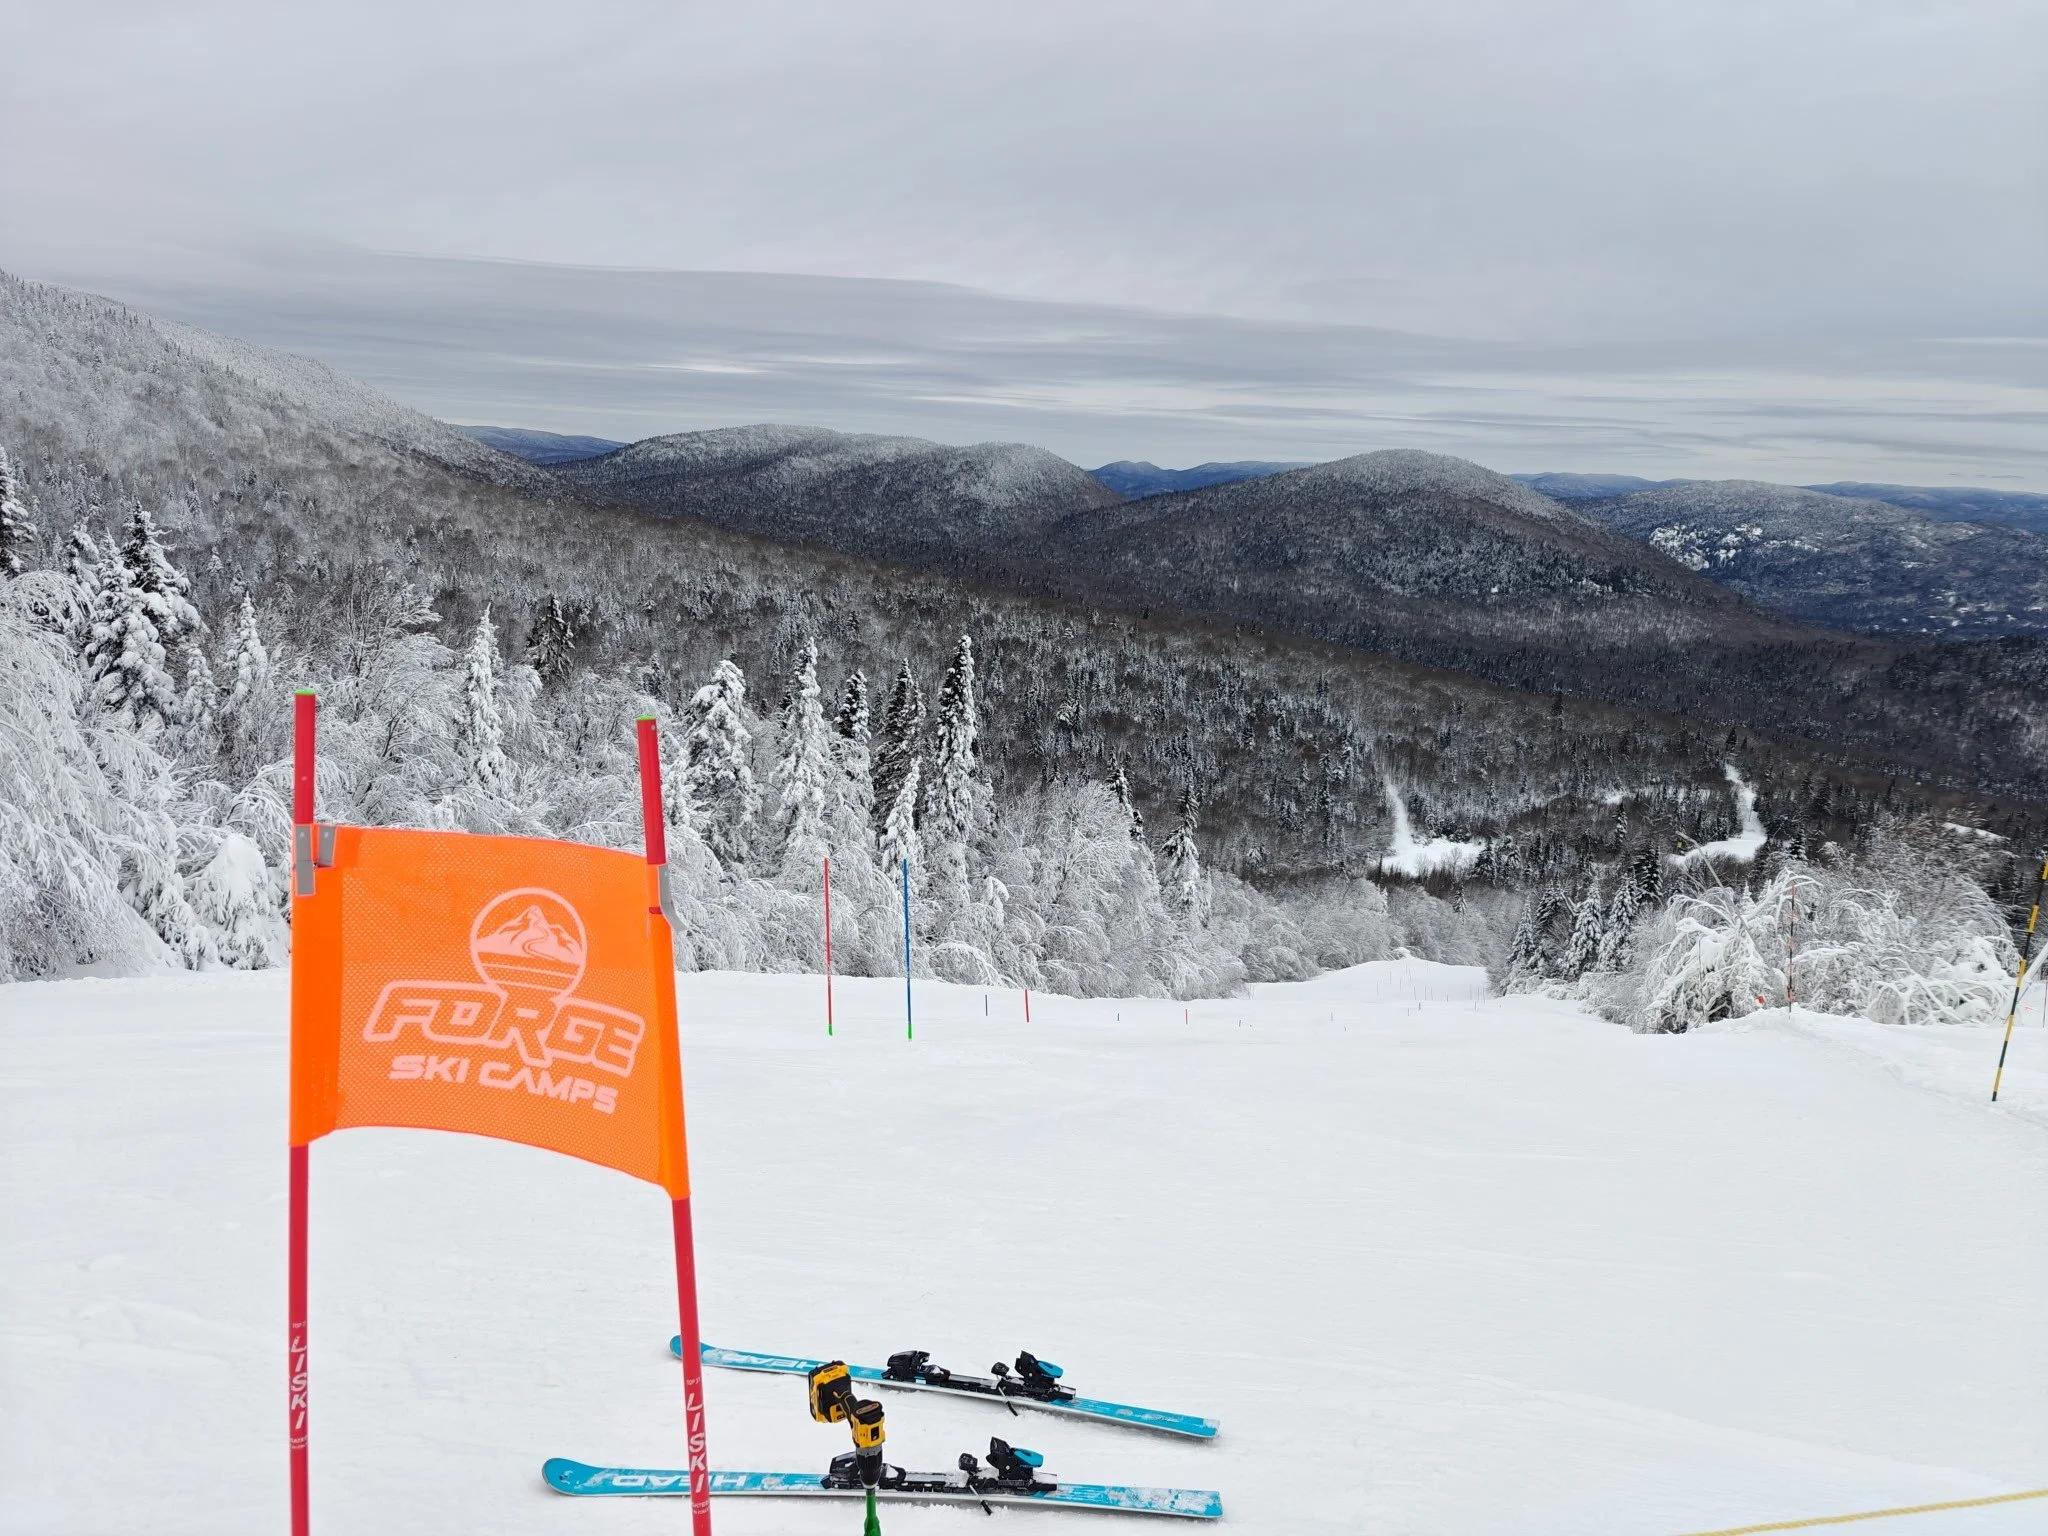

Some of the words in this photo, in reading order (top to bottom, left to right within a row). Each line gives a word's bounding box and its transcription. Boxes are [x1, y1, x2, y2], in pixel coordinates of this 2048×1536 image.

[363, 980, 645, 1077] FORGE
[389, 1055, 468, 1083] SKI
[479, 1062, 619, 1115] CAMPS
[290, 1335, 308, 1430] LISKI
[686, 1392, 706, 1494] LISKI
